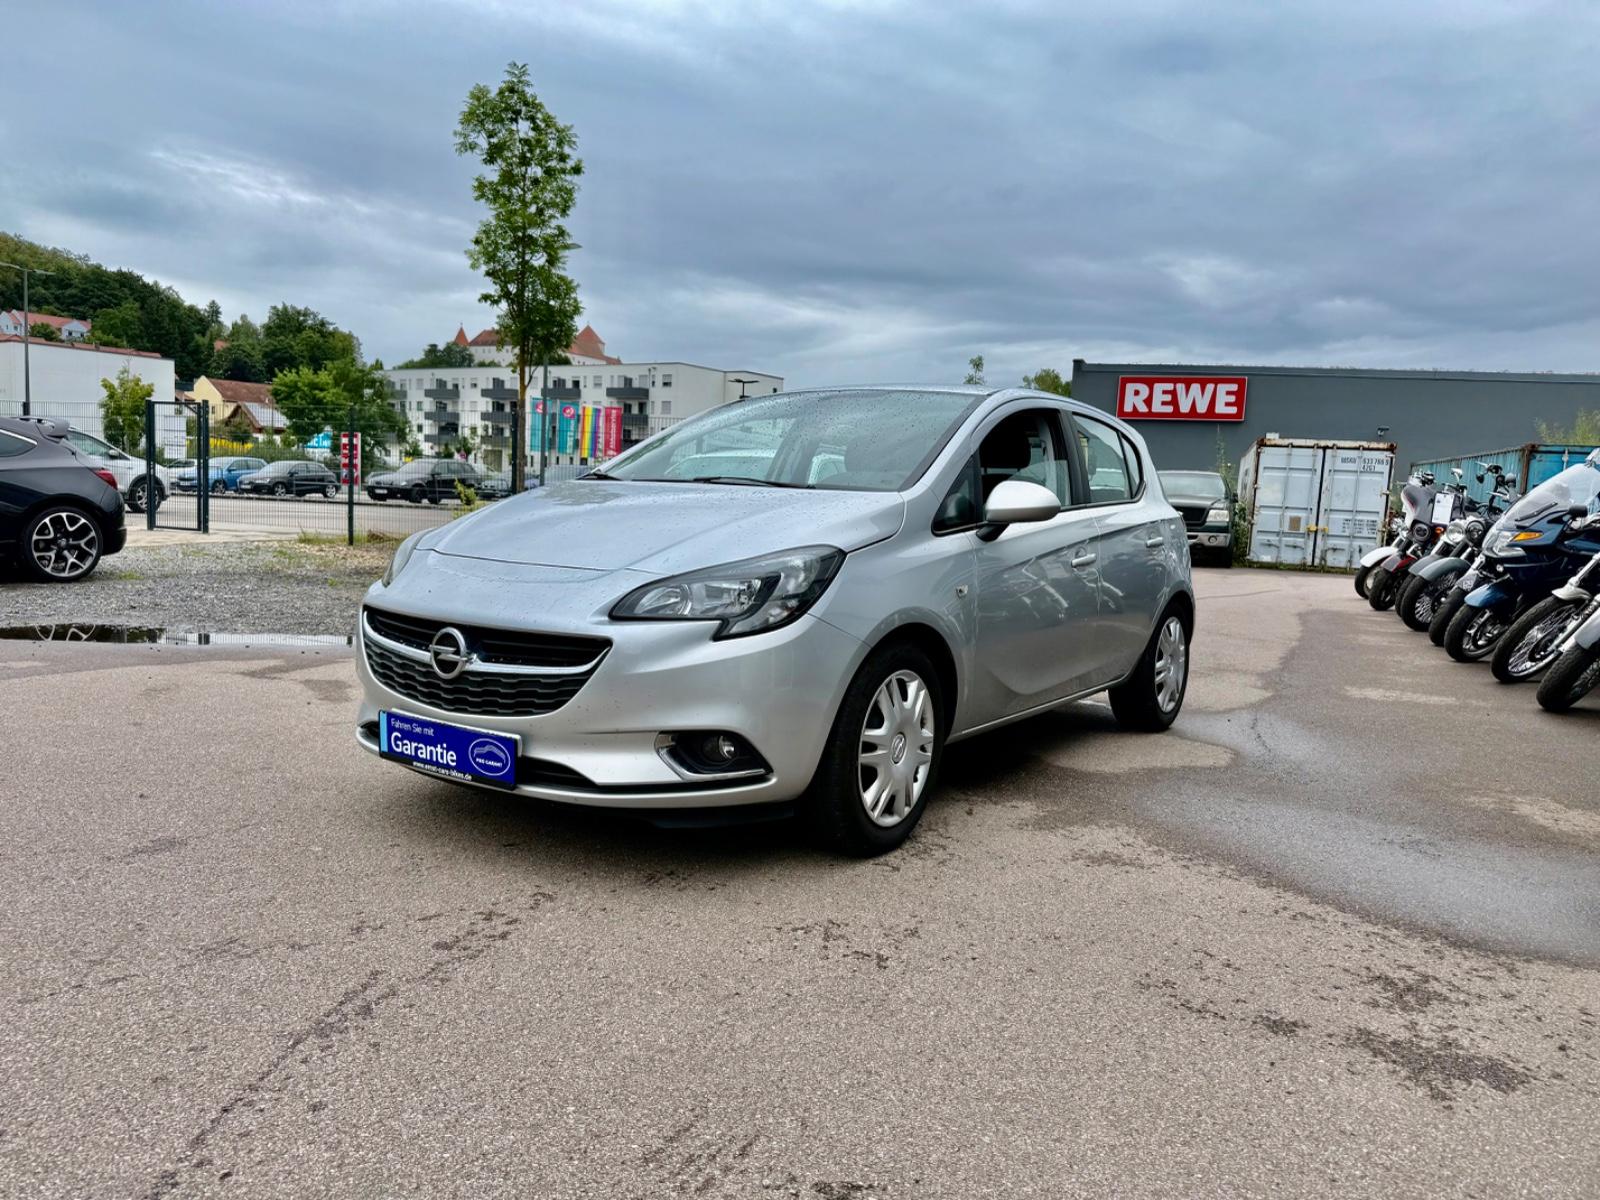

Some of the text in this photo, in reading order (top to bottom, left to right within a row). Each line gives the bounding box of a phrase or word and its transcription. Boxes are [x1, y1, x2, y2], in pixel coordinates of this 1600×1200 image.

[1123, 383, 1239, 414] REWE
[391, 718, 435, 737] Fahren Sie mit
[391, 732, 457, 766] Garantie
